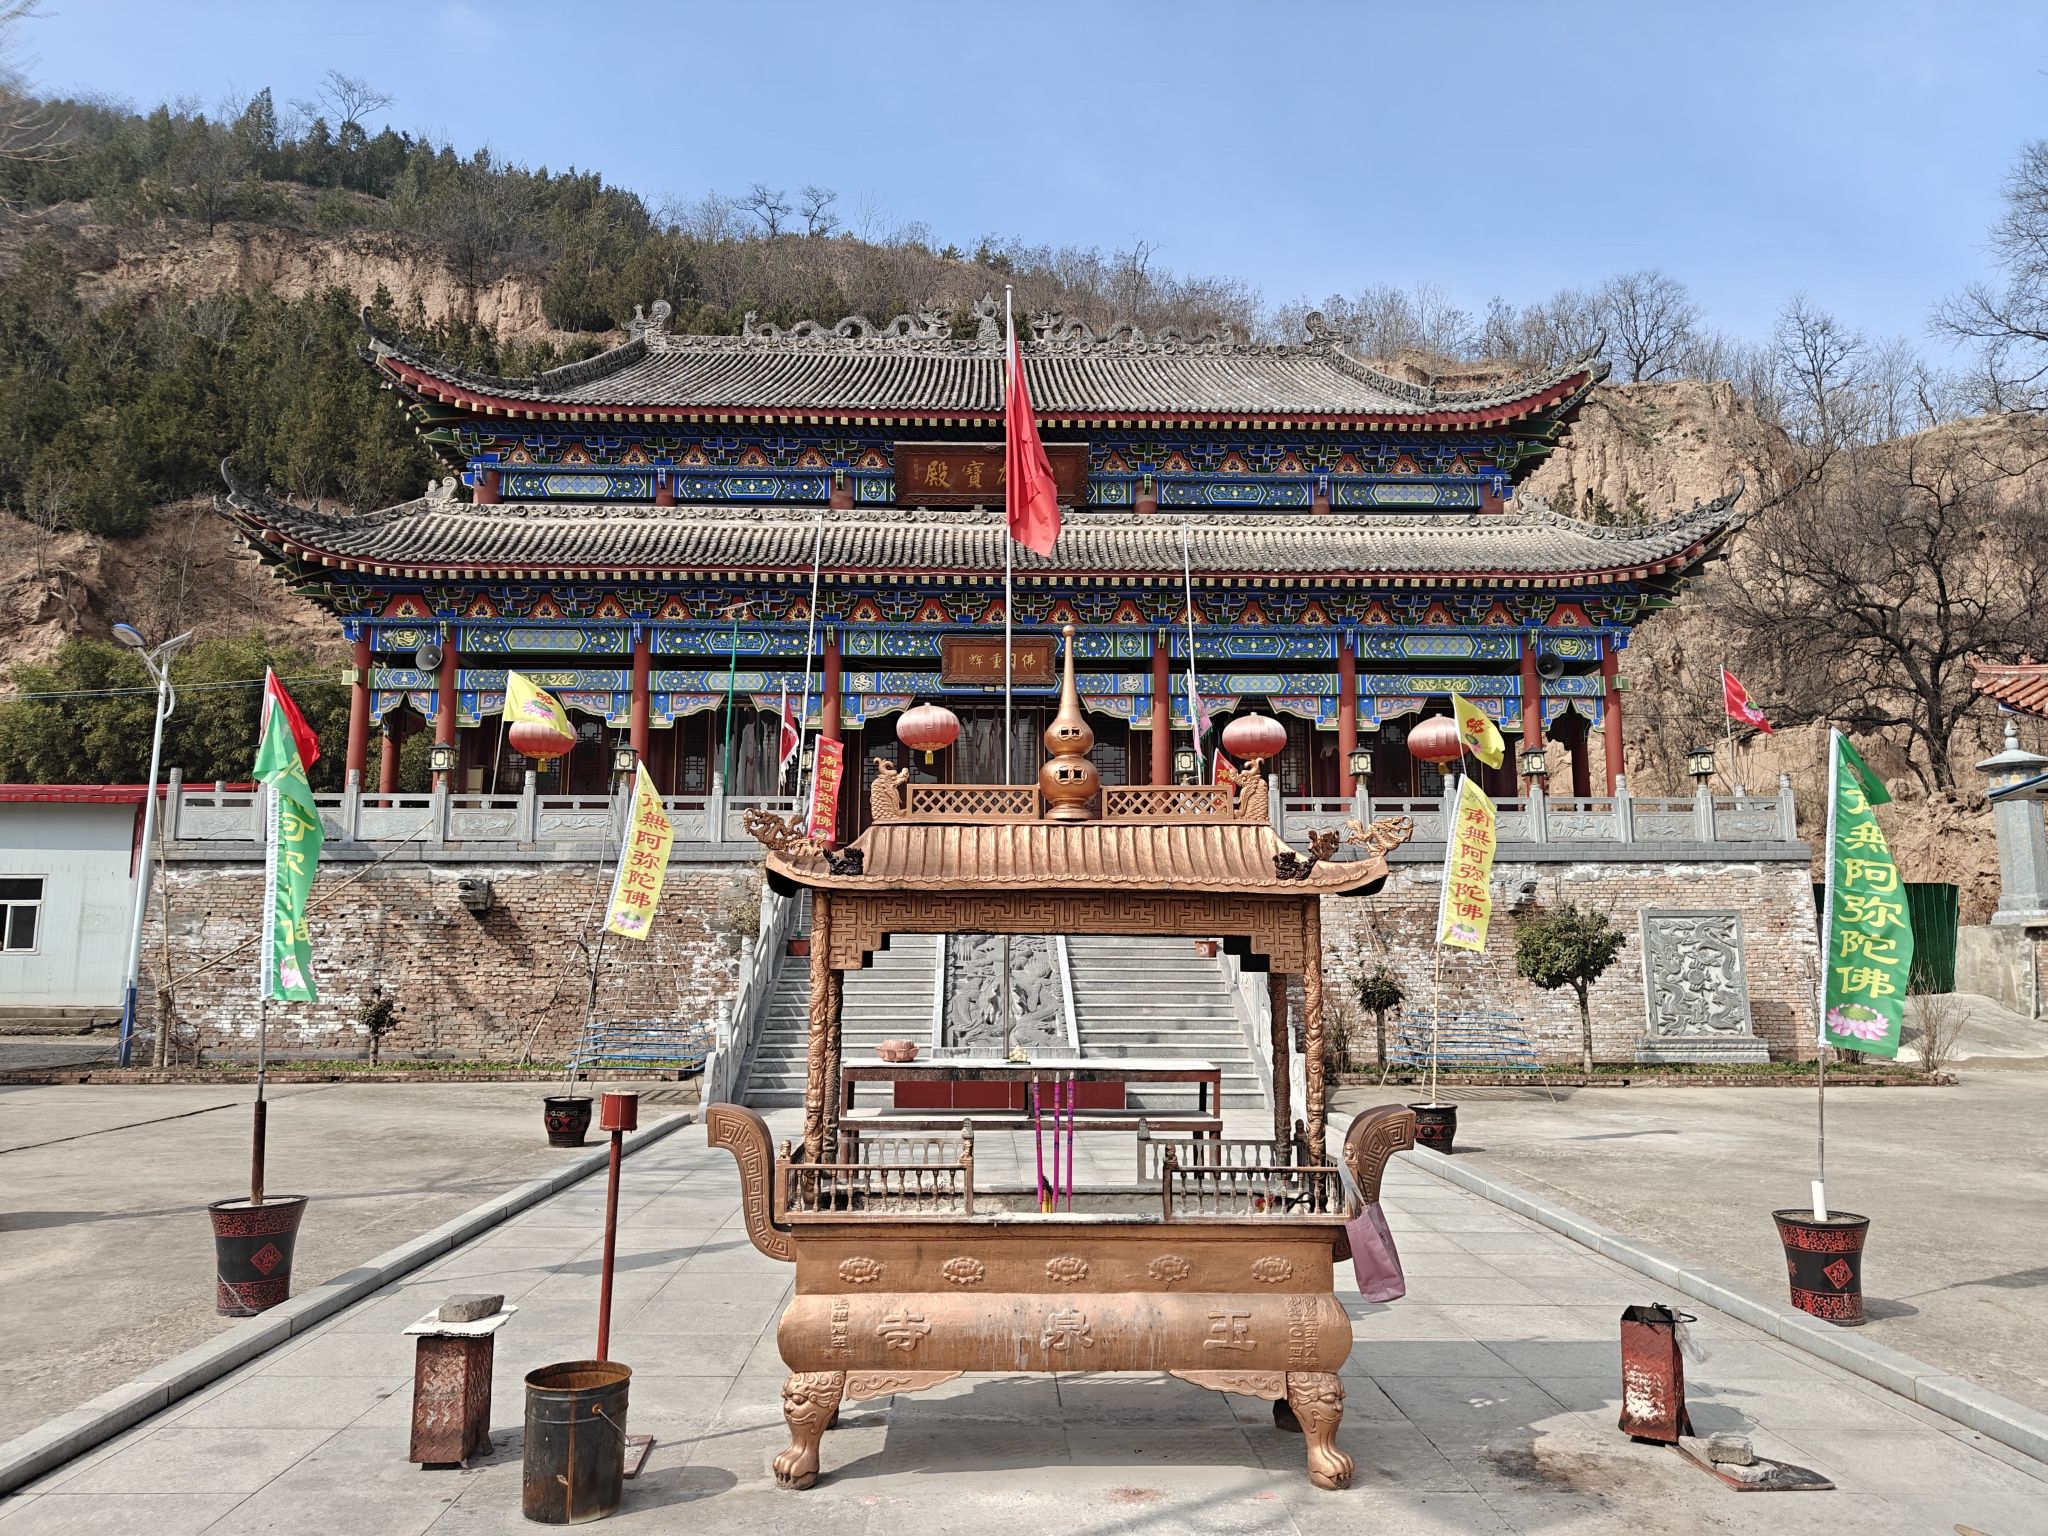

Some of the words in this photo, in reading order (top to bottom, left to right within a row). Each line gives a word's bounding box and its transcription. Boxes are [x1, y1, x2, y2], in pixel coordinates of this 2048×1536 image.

[1452, 806, 1493, 922] 南無阿弥陀佛
